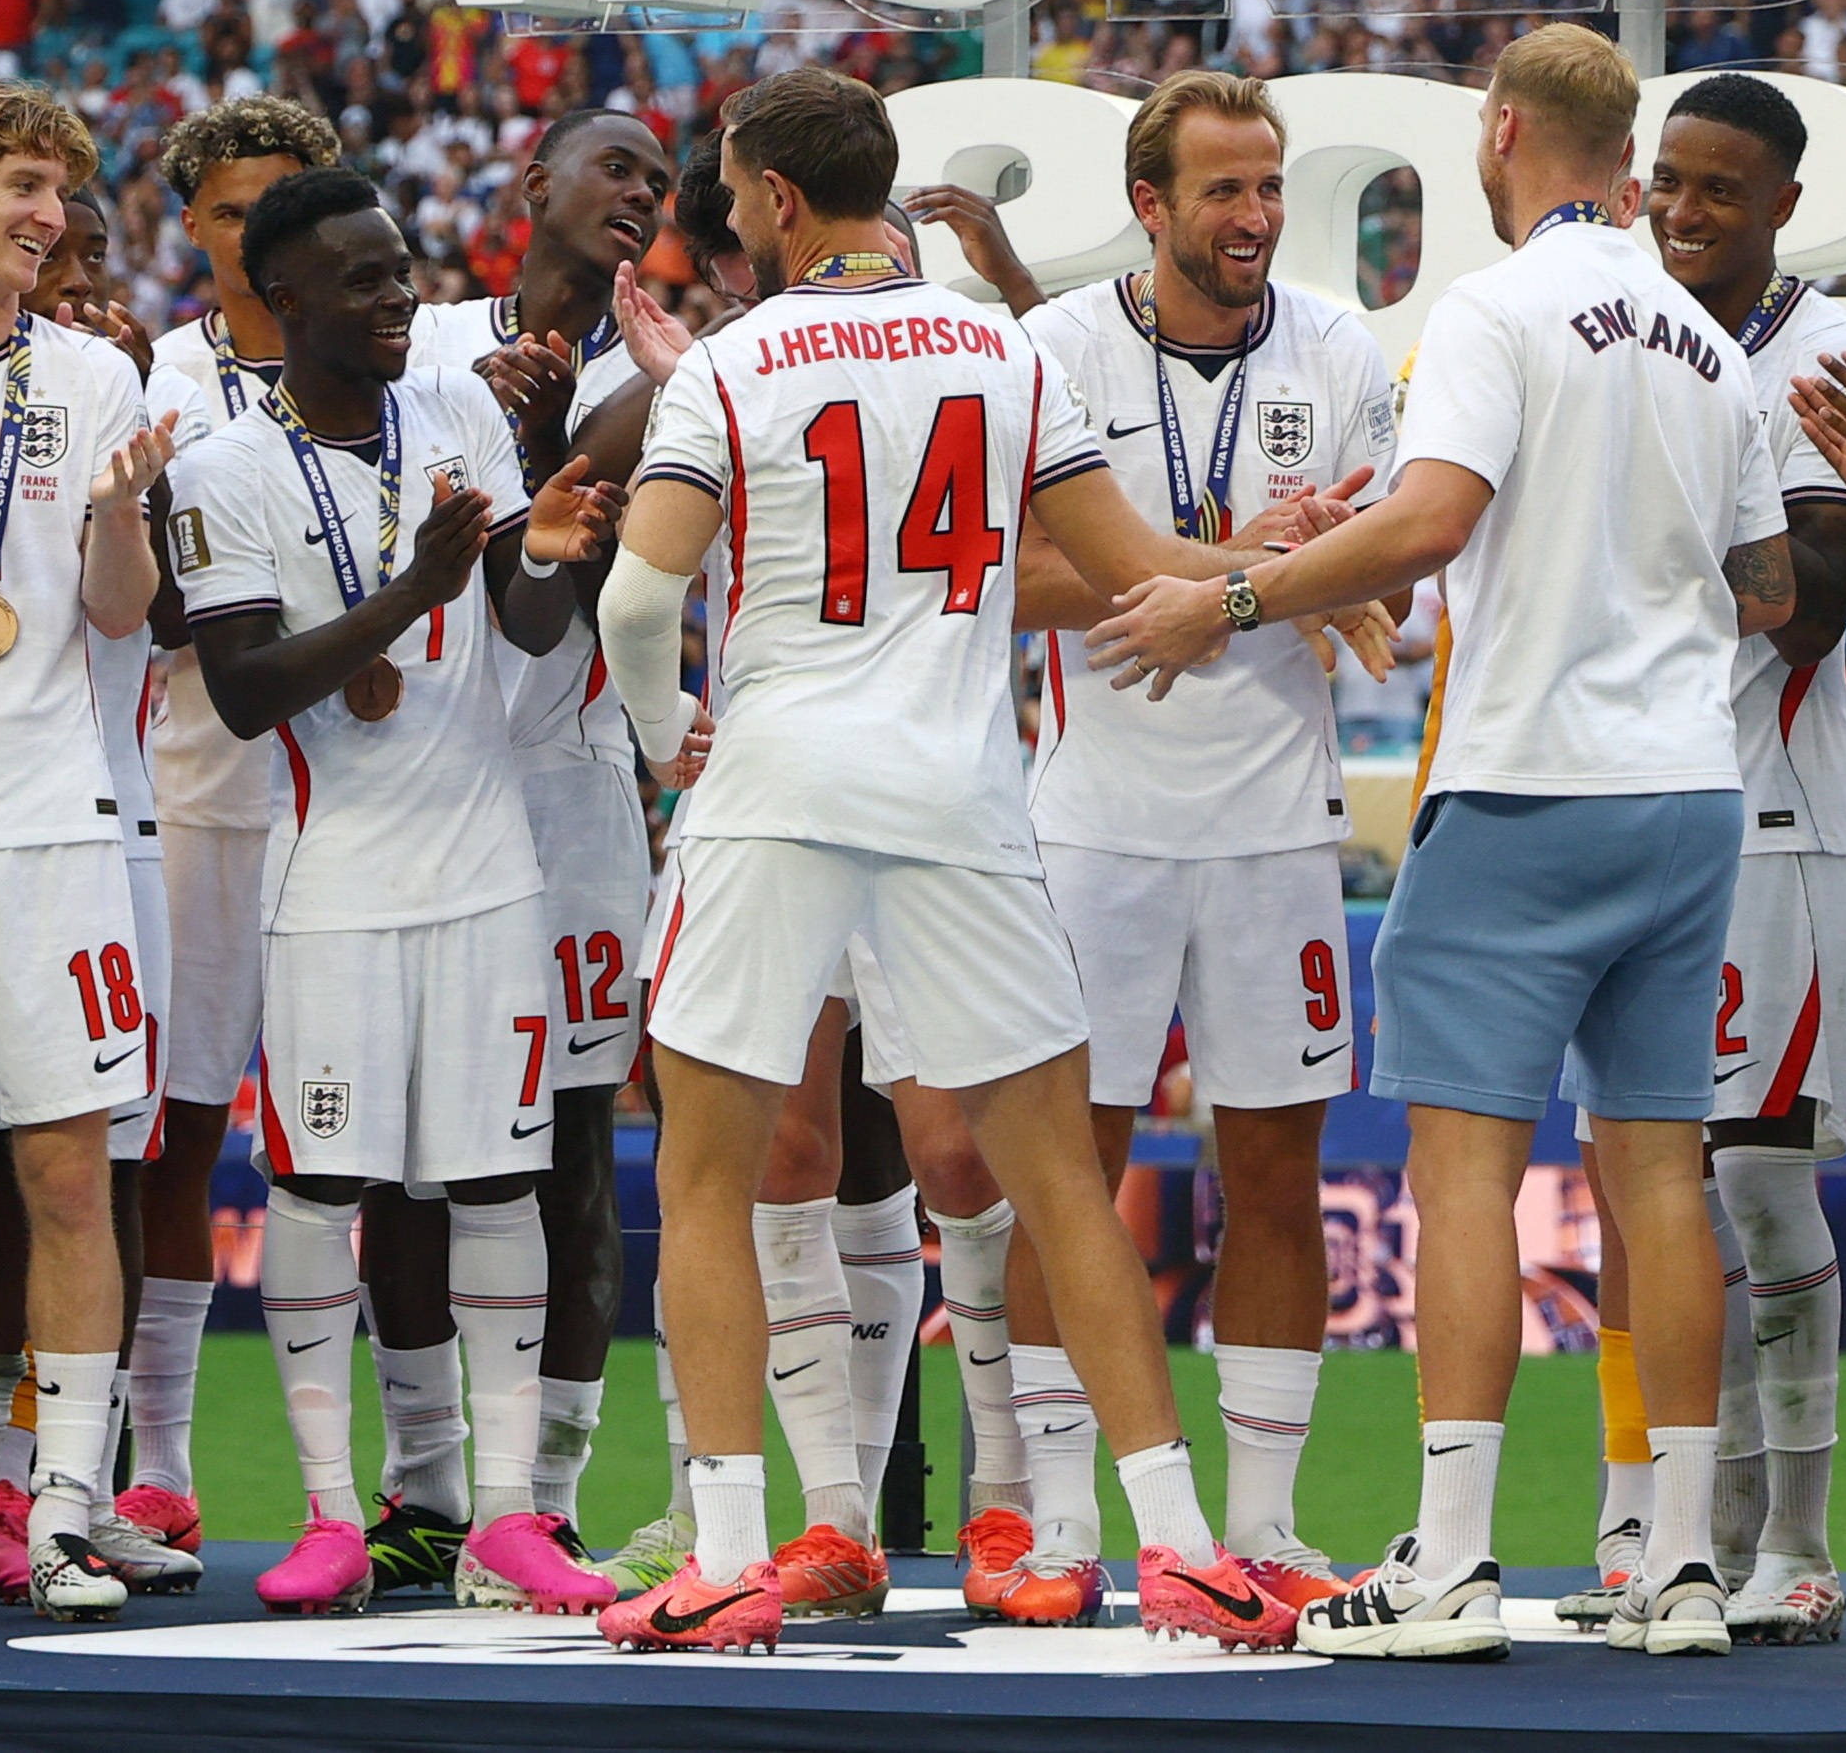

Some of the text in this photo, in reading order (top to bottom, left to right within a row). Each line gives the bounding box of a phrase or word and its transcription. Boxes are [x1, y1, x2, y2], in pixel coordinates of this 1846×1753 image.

[755, 316, 1006, 376] J.HENDERSON
[1163, 383, 1177, 429] WORLD
[1213, 376, 1242, 479] FIFA WORLD CUP
[2, 435, 16, 480] 2026
[386, 421, 397, 460] 2026
[1168, 431, 1182, 457] CUP
[20, 475, 58, 488] FRANCE
[1173, 459, 1189, 506] 2026
[1267, 473, 1304, 487] FRANCE
[302, 452, 357, 594] FIFA WORLD CUP 2026
[803, 393, 1005, 627] 14
[68, 941, 144, 1042] 18
[554, 930, 630, 1024] 12
[1299, 939, 1341, 1032] 9
[513, 1015, 548, 1107] 7
[853, 1323, 890, 1341] NG
